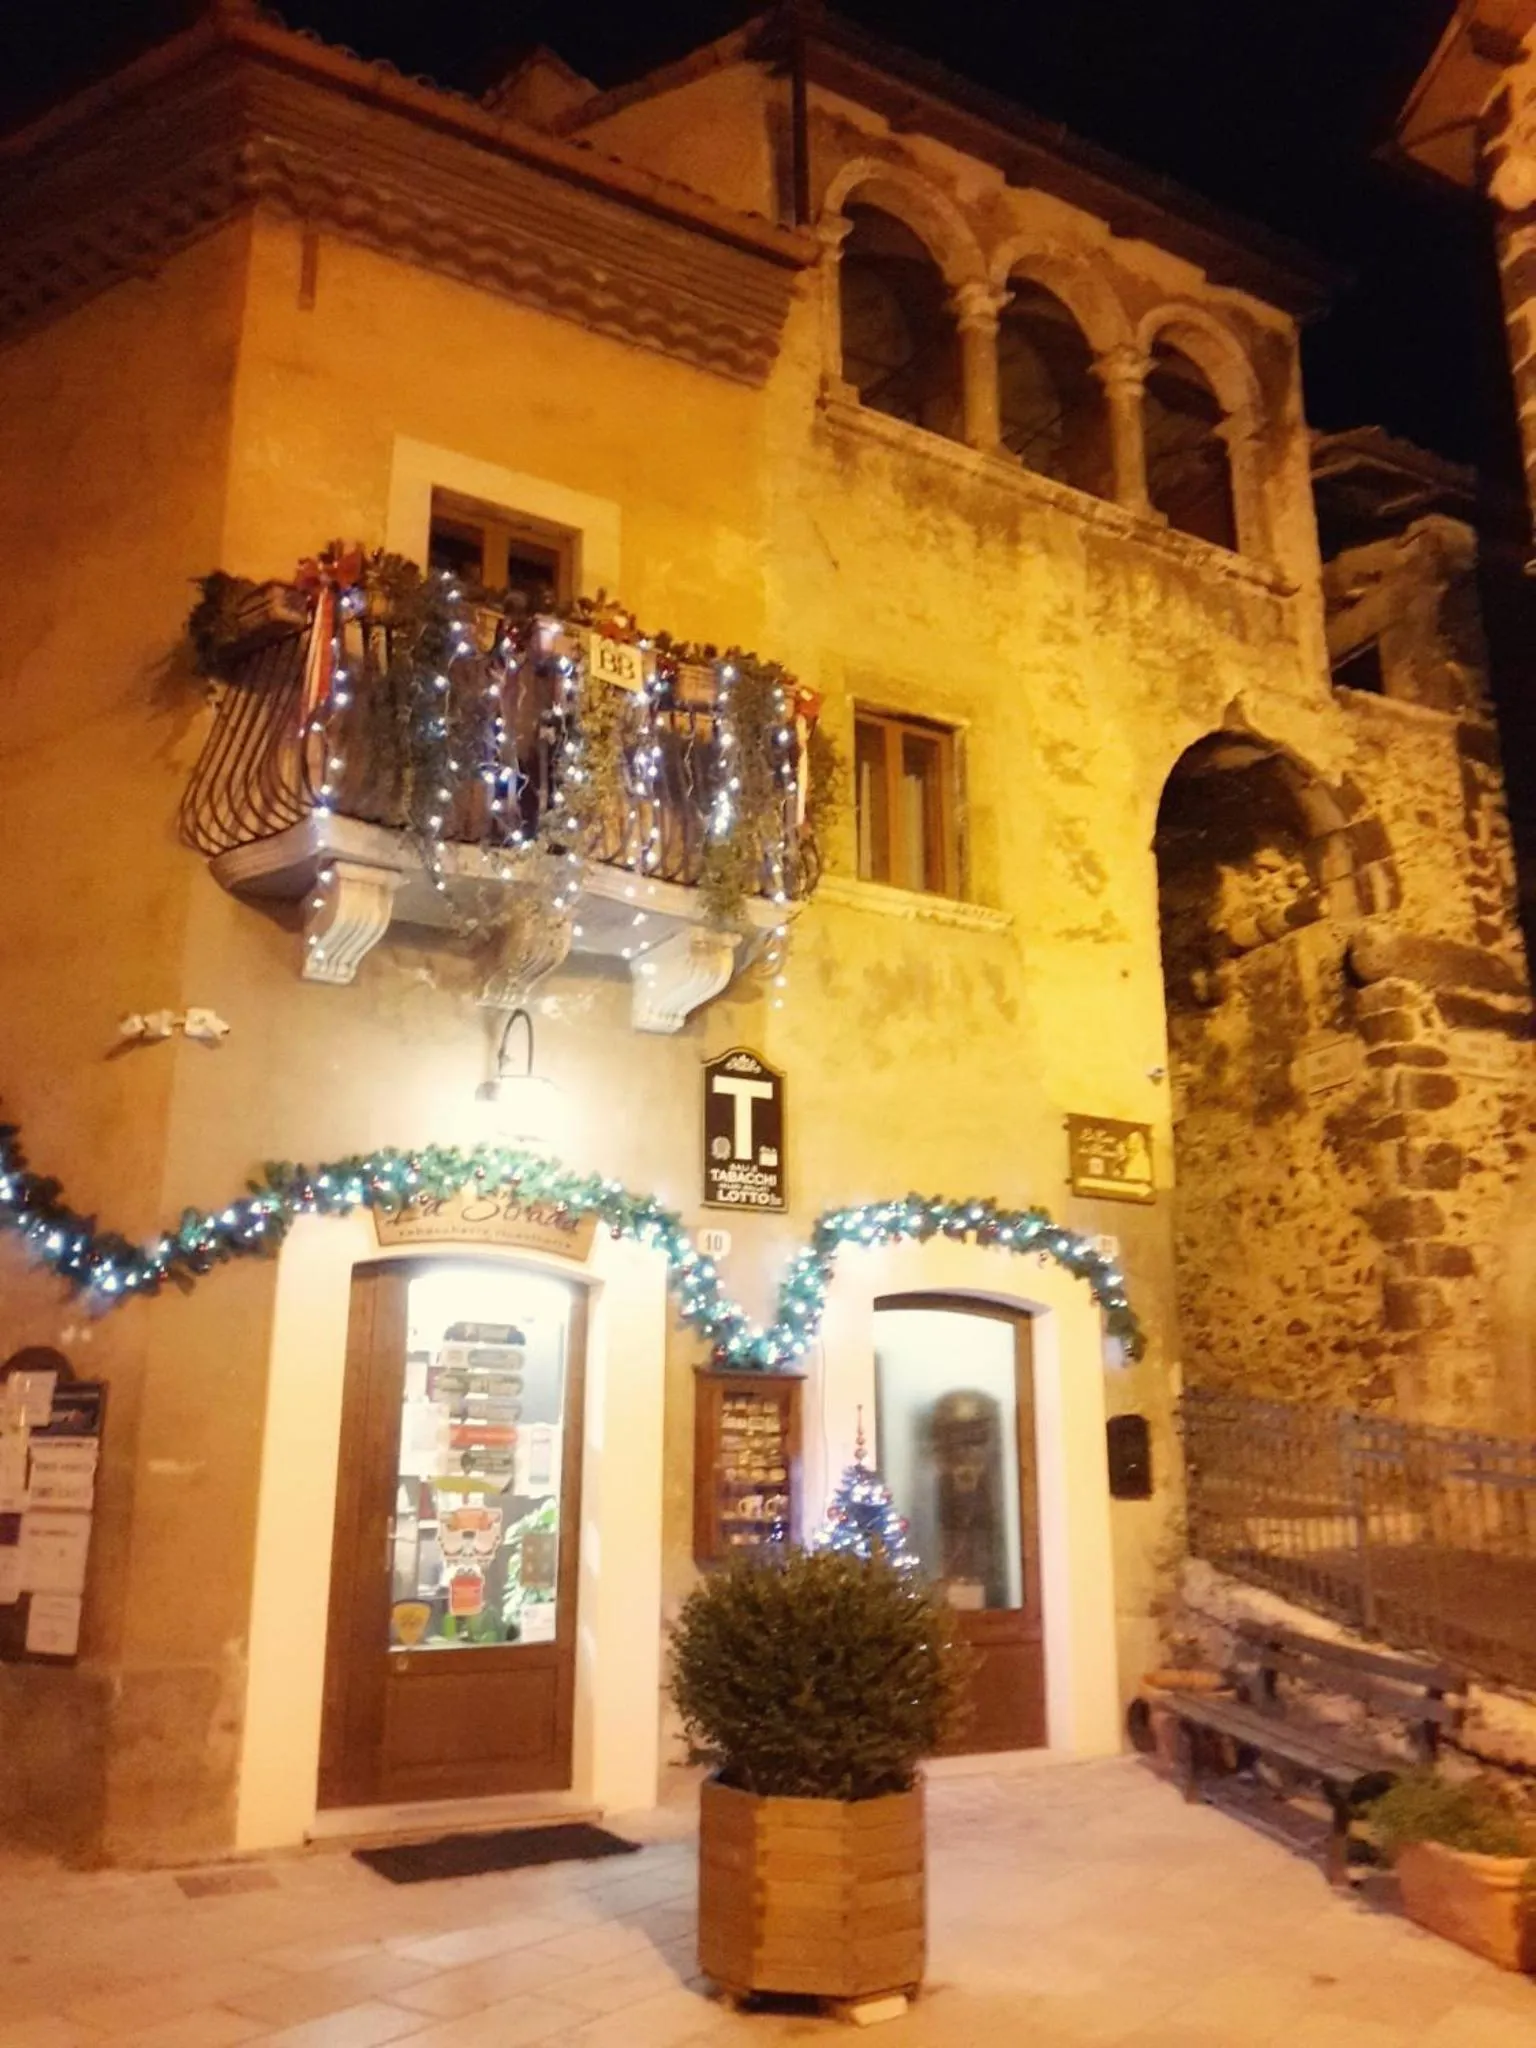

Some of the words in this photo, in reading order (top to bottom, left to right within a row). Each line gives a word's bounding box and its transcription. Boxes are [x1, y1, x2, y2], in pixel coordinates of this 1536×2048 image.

[712, 1074, 774, 1161] T
[710, 1168, 777, 1186] TABACCHI
[717, 1189, 770, 1205] LOTTO
[706, 1233, 723, 1252] 10
